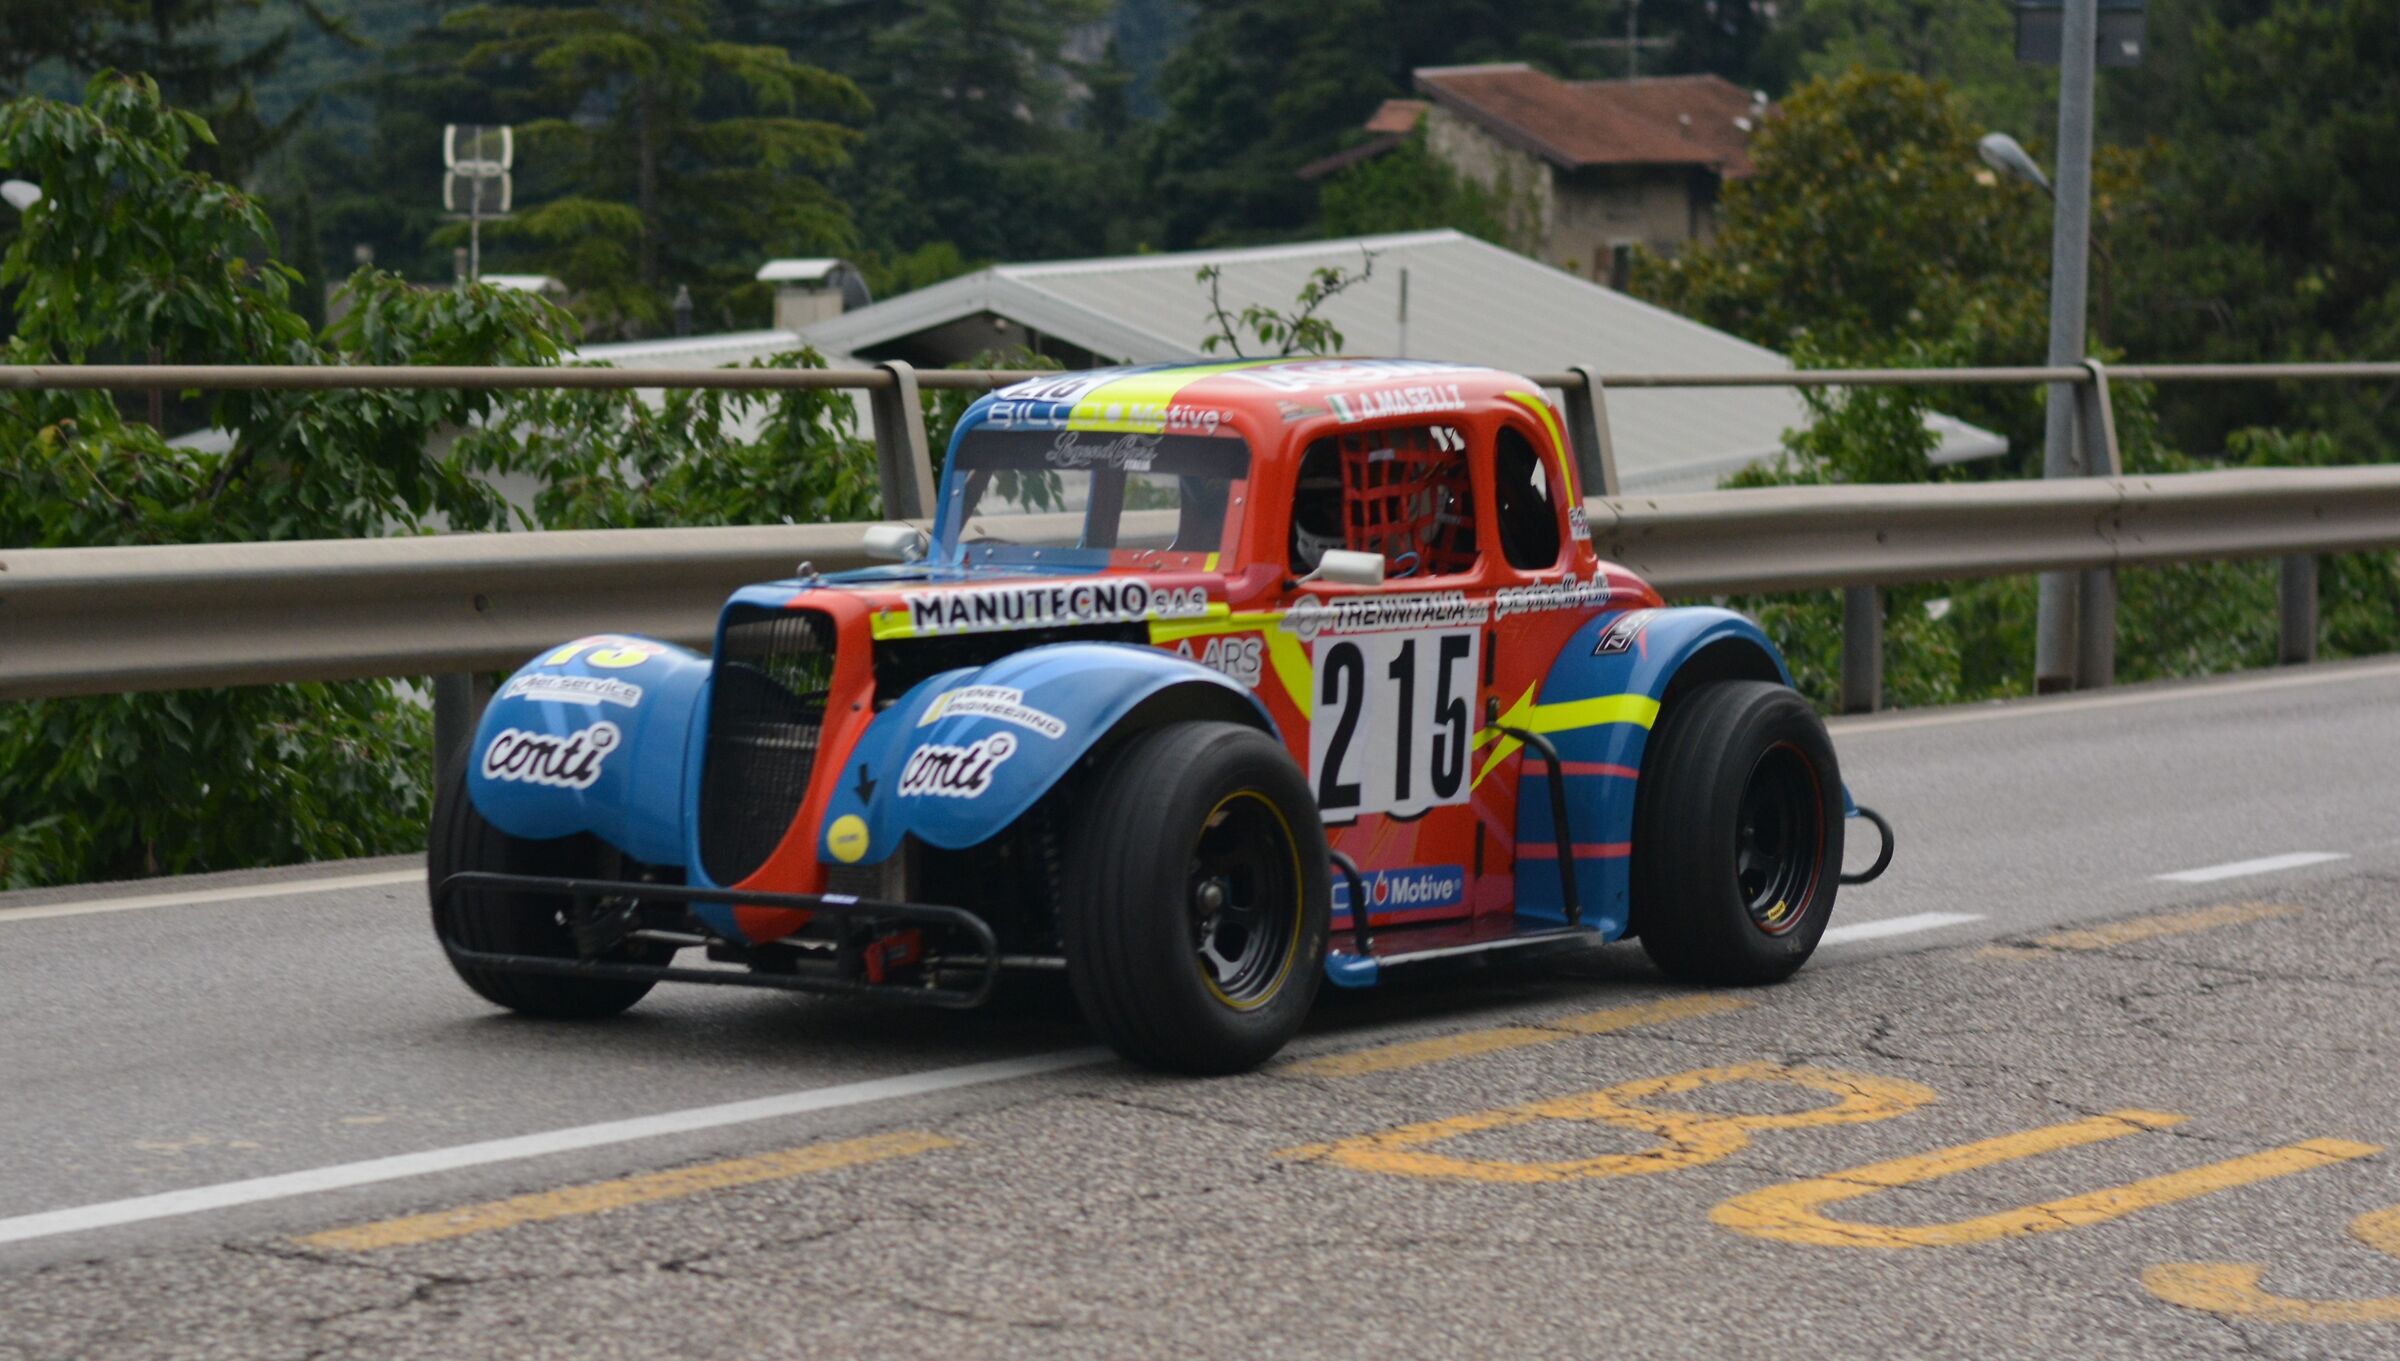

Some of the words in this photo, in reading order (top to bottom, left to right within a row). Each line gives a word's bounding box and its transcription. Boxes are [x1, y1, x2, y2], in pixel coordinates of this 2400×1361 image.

[1129, 403, 1219, 431] Motive
[914, 582, 1148, 628] MANUTECNO
[1333, 595, 1464, 628] TRENNITALIA
[1318, 634, 1471, 809] 215
[489, 727, 613, 781] conti
[902, 737, 1008, 791] conti
[1391, 873, 1454, 904] Motive
